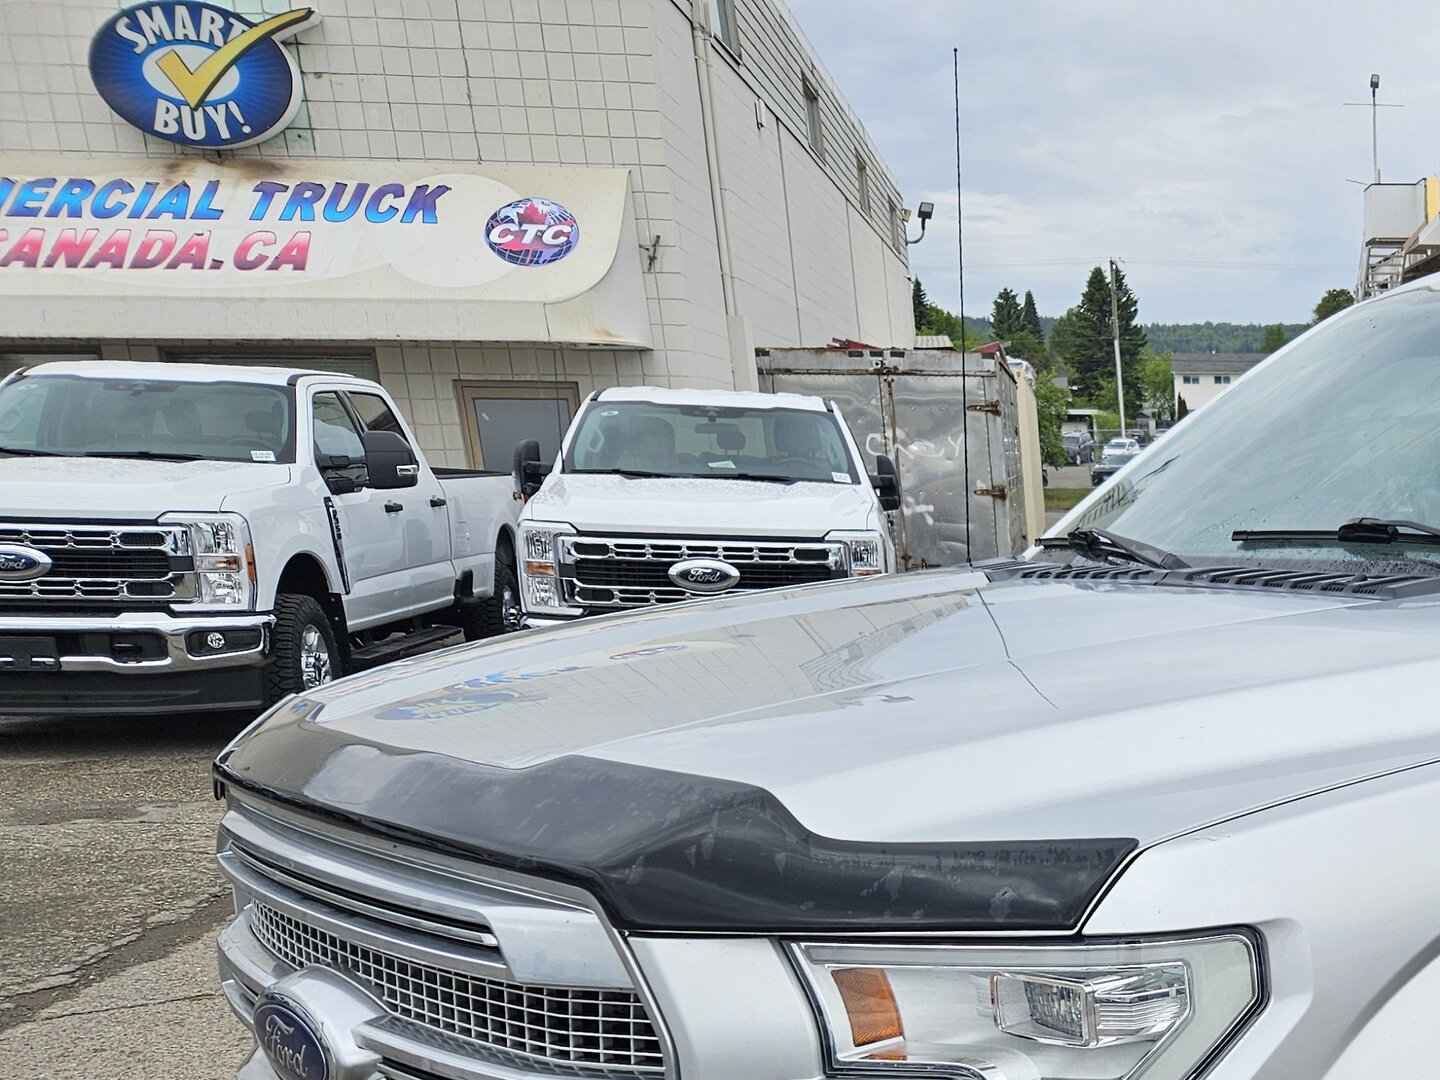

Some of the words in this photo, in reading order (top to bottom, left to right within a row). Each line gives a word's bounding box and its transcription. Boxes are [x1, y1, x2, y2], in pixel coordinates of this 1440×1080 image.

[114, 4, 251, 55] SMART
[153, 97, 252, 141] BUY!
[248, 179, 452, 224] TRUCK
[0, 226, 312, 271] ANADA.CA
[488, 222, 572, 245] CTC
[687, 567, 721, 582] Ford
[264, 1013, 309, 1078] Ford
